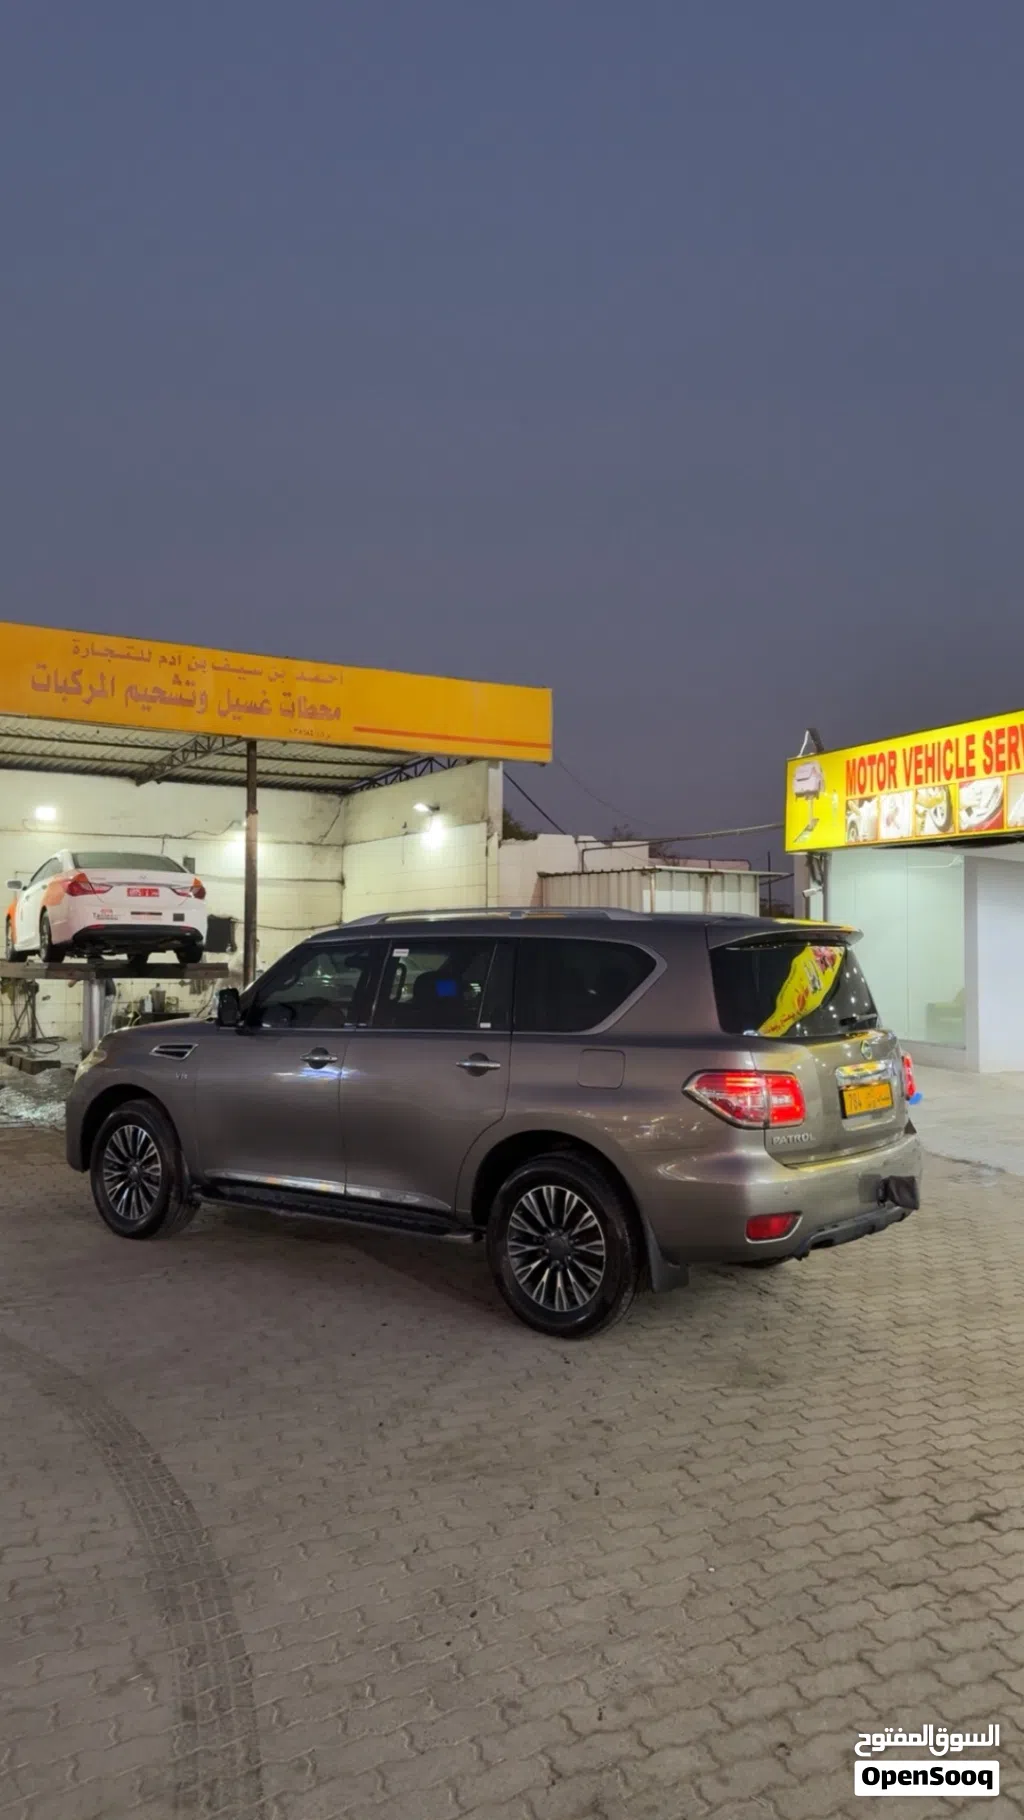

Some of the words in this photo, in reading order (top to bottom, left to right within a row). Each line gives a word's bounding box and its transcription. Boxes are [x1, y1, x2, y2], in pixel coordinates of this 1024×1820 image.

[72, 638, 152, 664] للتجارة
[159, 653, 182, 668] ادم
[187, 656, 209, 674] بن
[211, 657, 263, 682] سيف
[267, 664, 286, 684] بن
[30, 663, 116, 705] المركبات
[124, 673, 208, 714] وتشحيم
[217, 687, 273, 721] غسيل
[279, 691, 341, 721] محطات
[845, 750, 897, 796] MOTOR
[902, 734, 976, 787] VEHICLE
[772, 1132, 816, 1146] PATROL
